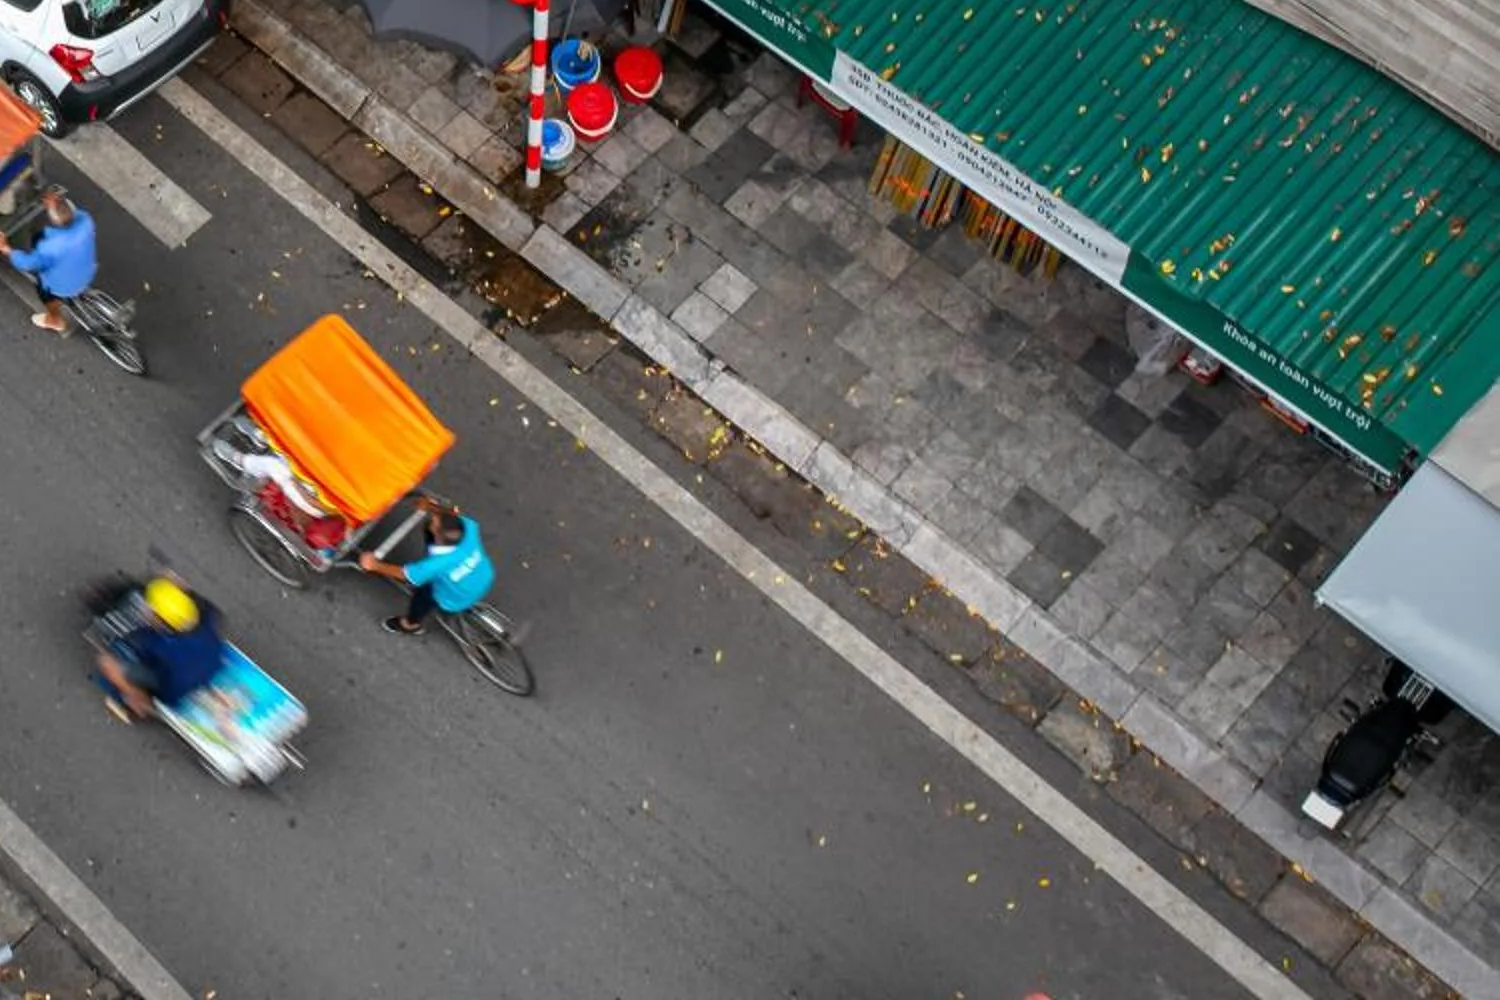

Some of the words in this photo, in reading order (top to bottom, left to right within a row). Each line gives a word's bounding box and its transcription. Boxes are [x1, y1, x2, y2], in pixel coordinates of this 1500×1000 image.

[1259, 349, 1277, 367] an
[1279, 360, 1309, 390] toàn
[1312, 385, 1343, 412] vượt
[1345, 405, 1372, 431] trội
